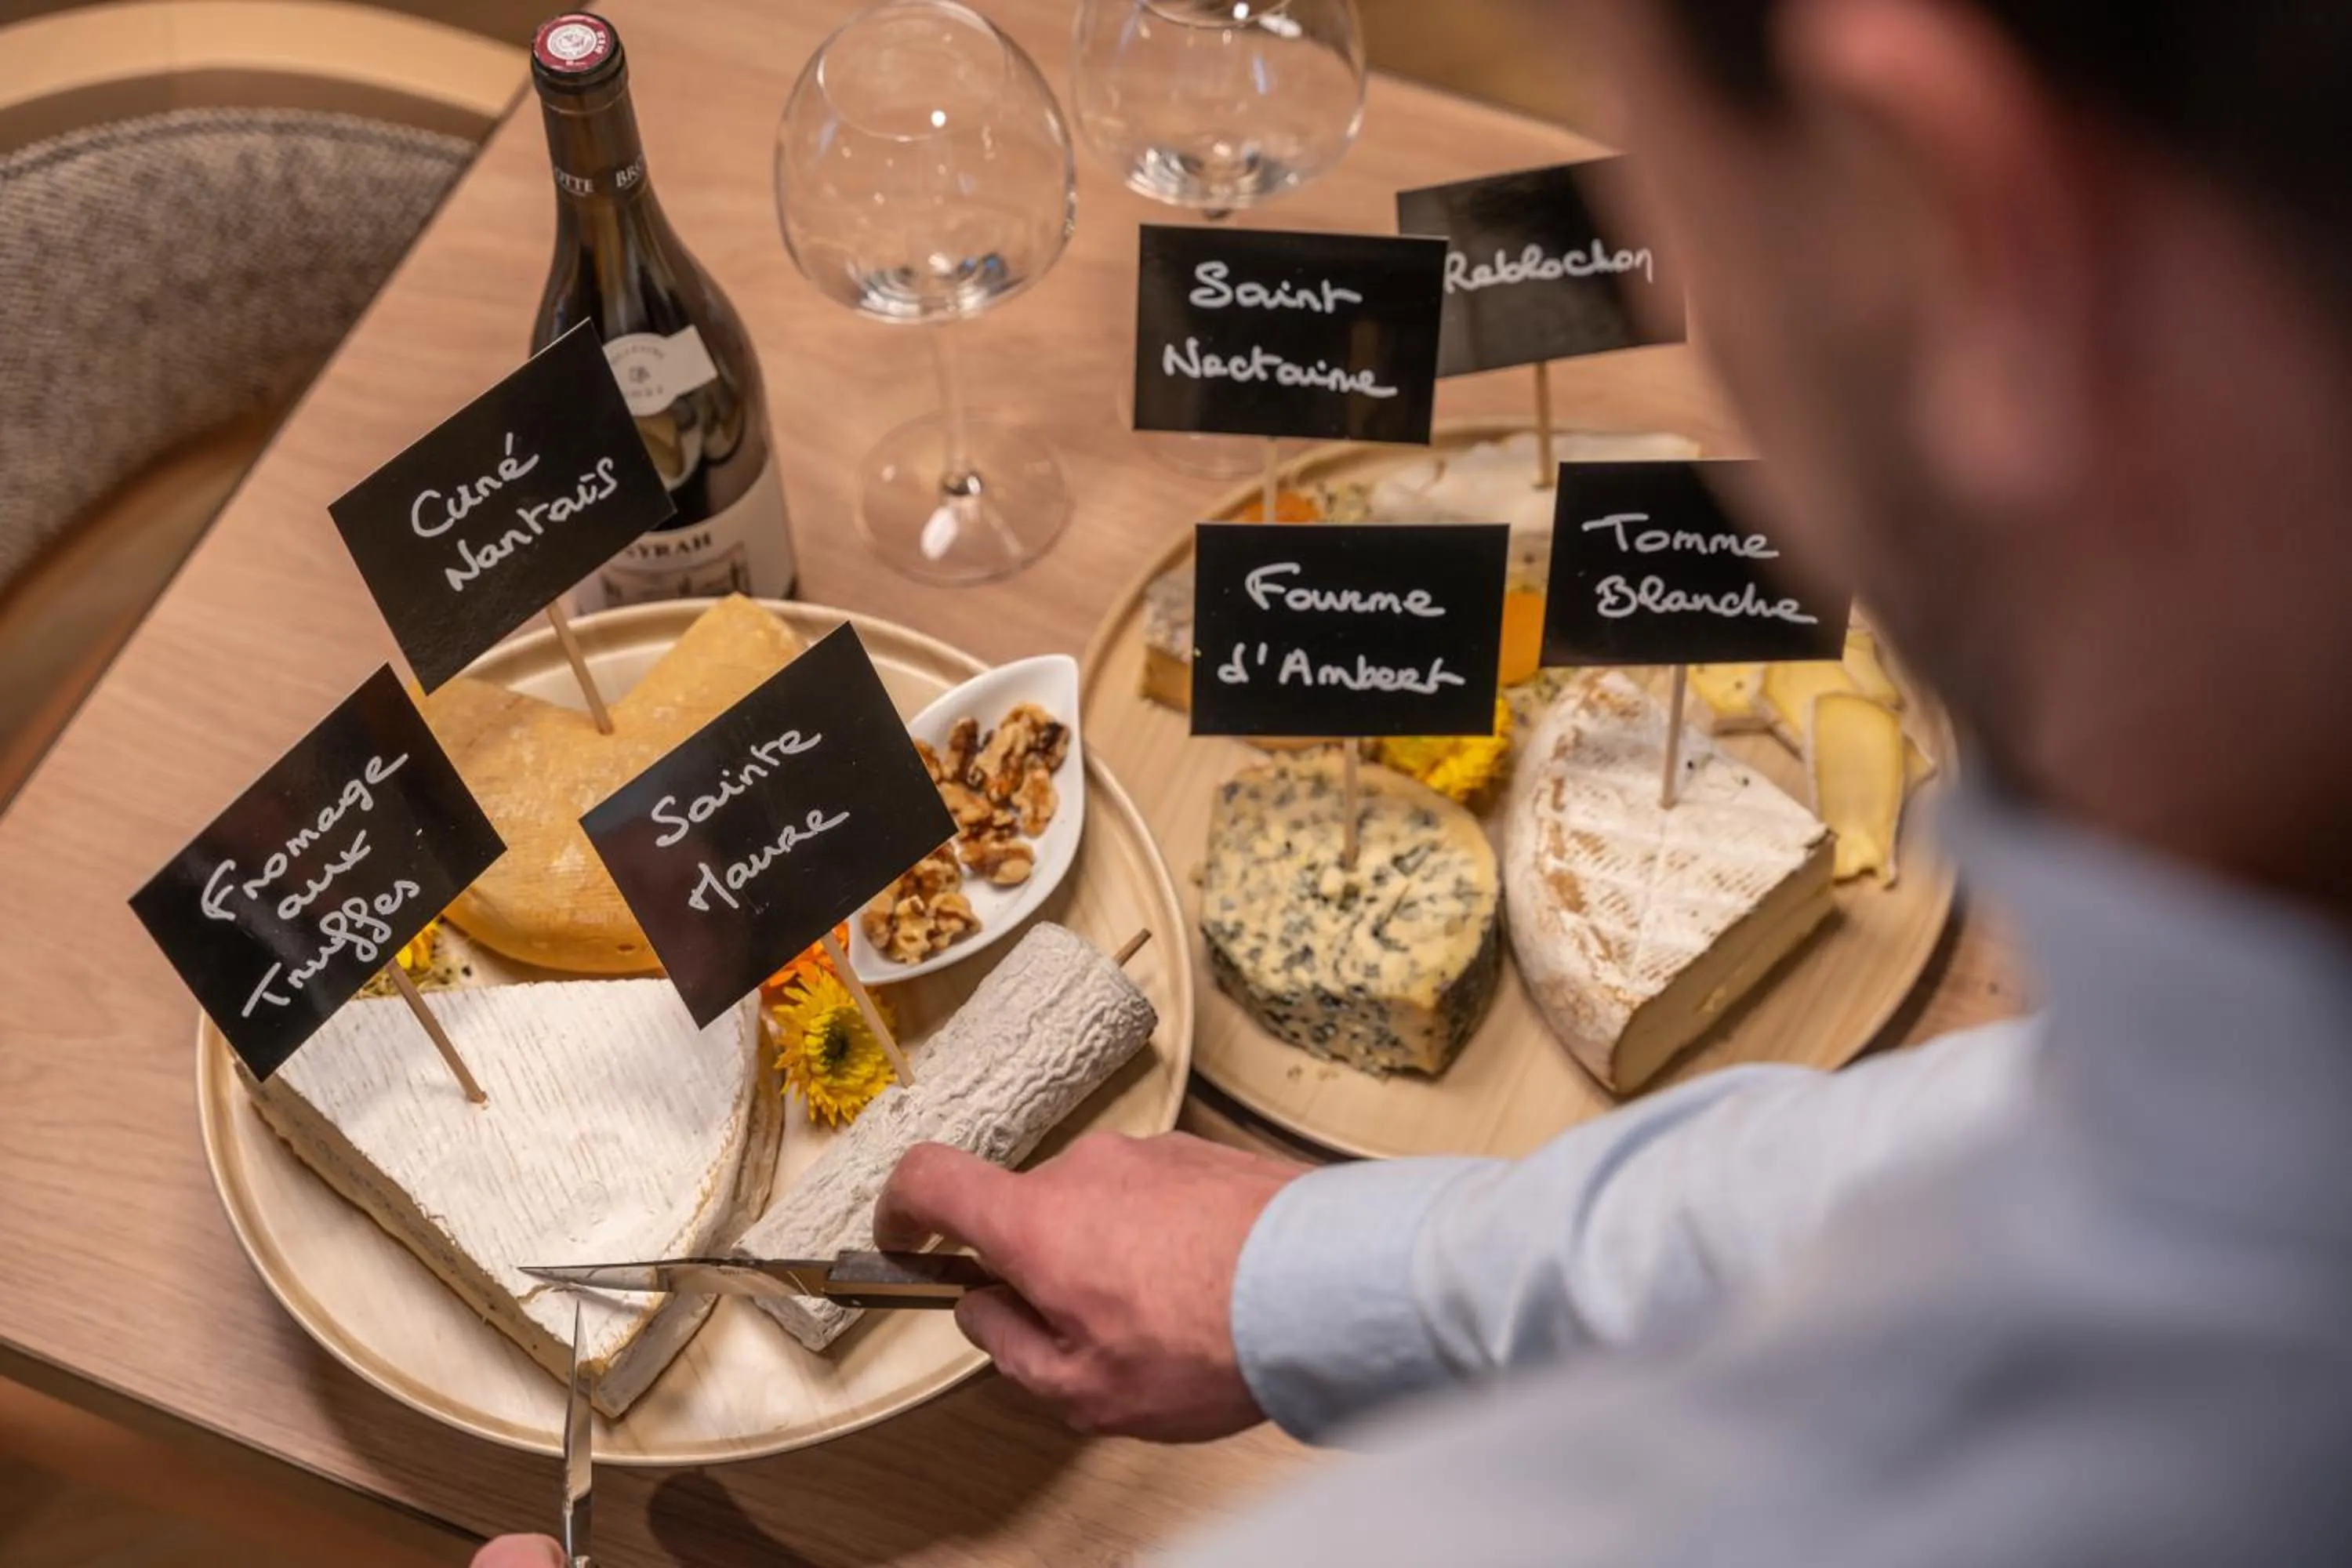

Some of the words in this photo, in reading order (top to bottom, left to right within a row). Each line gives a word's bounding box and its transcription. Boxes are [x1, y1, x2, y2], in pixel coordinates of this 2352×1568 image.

[1190, 262, 1361, 313] Saint
[1444, 241, 1653, 294] Reblochon
[1582, 514, 1779, 557] Tomme
[1245, 563, 1445, 616] Fourme
[1596, 575, 1817, 623] Blanche
[1218, 643, 1465, 693] d'Ambert
[651, 731, 822, 847] Sainte
[201, 753, 408, 920] Fromage
[278, 829, 370, 920] aux
[242, 880, 419, 1017] Truffes
